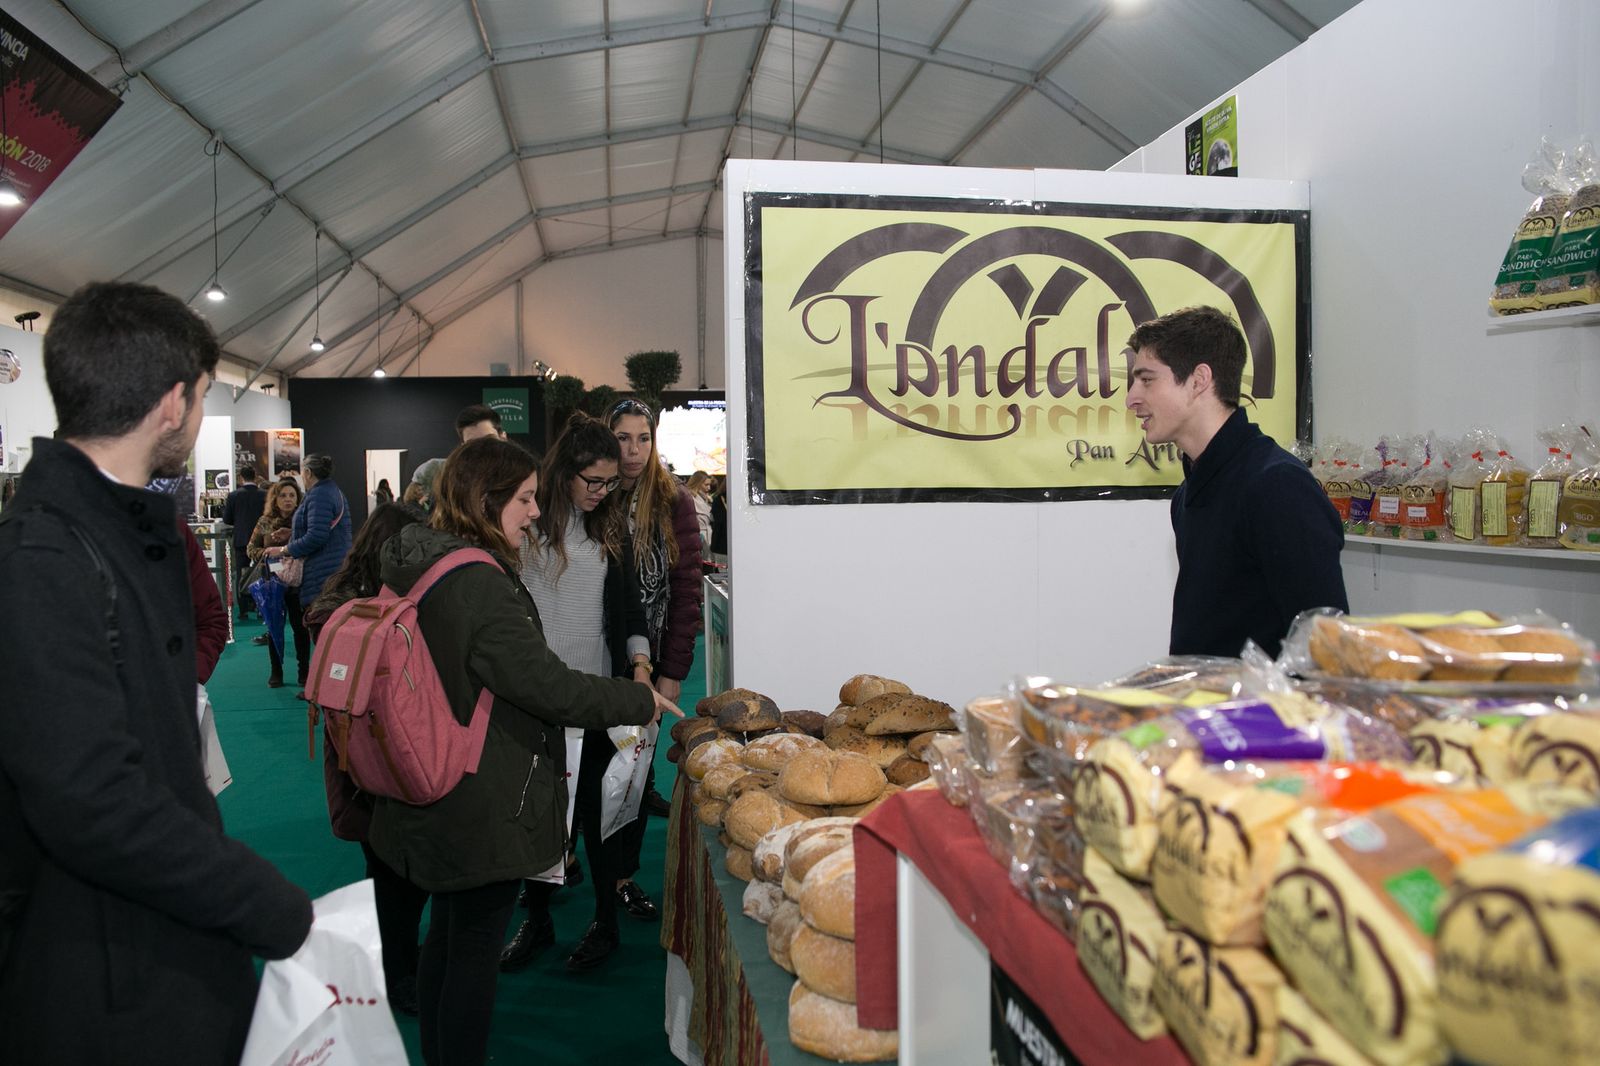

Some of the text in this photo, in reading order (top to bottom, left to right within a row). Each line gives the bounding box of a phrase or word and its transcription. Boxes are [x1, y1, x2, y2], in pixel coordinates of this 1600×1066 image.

[20, 150, 52, 173] 2018
[1546, 248, 1599, 267] SANDWICH
[1066, 439, 1115, 467] Pan
